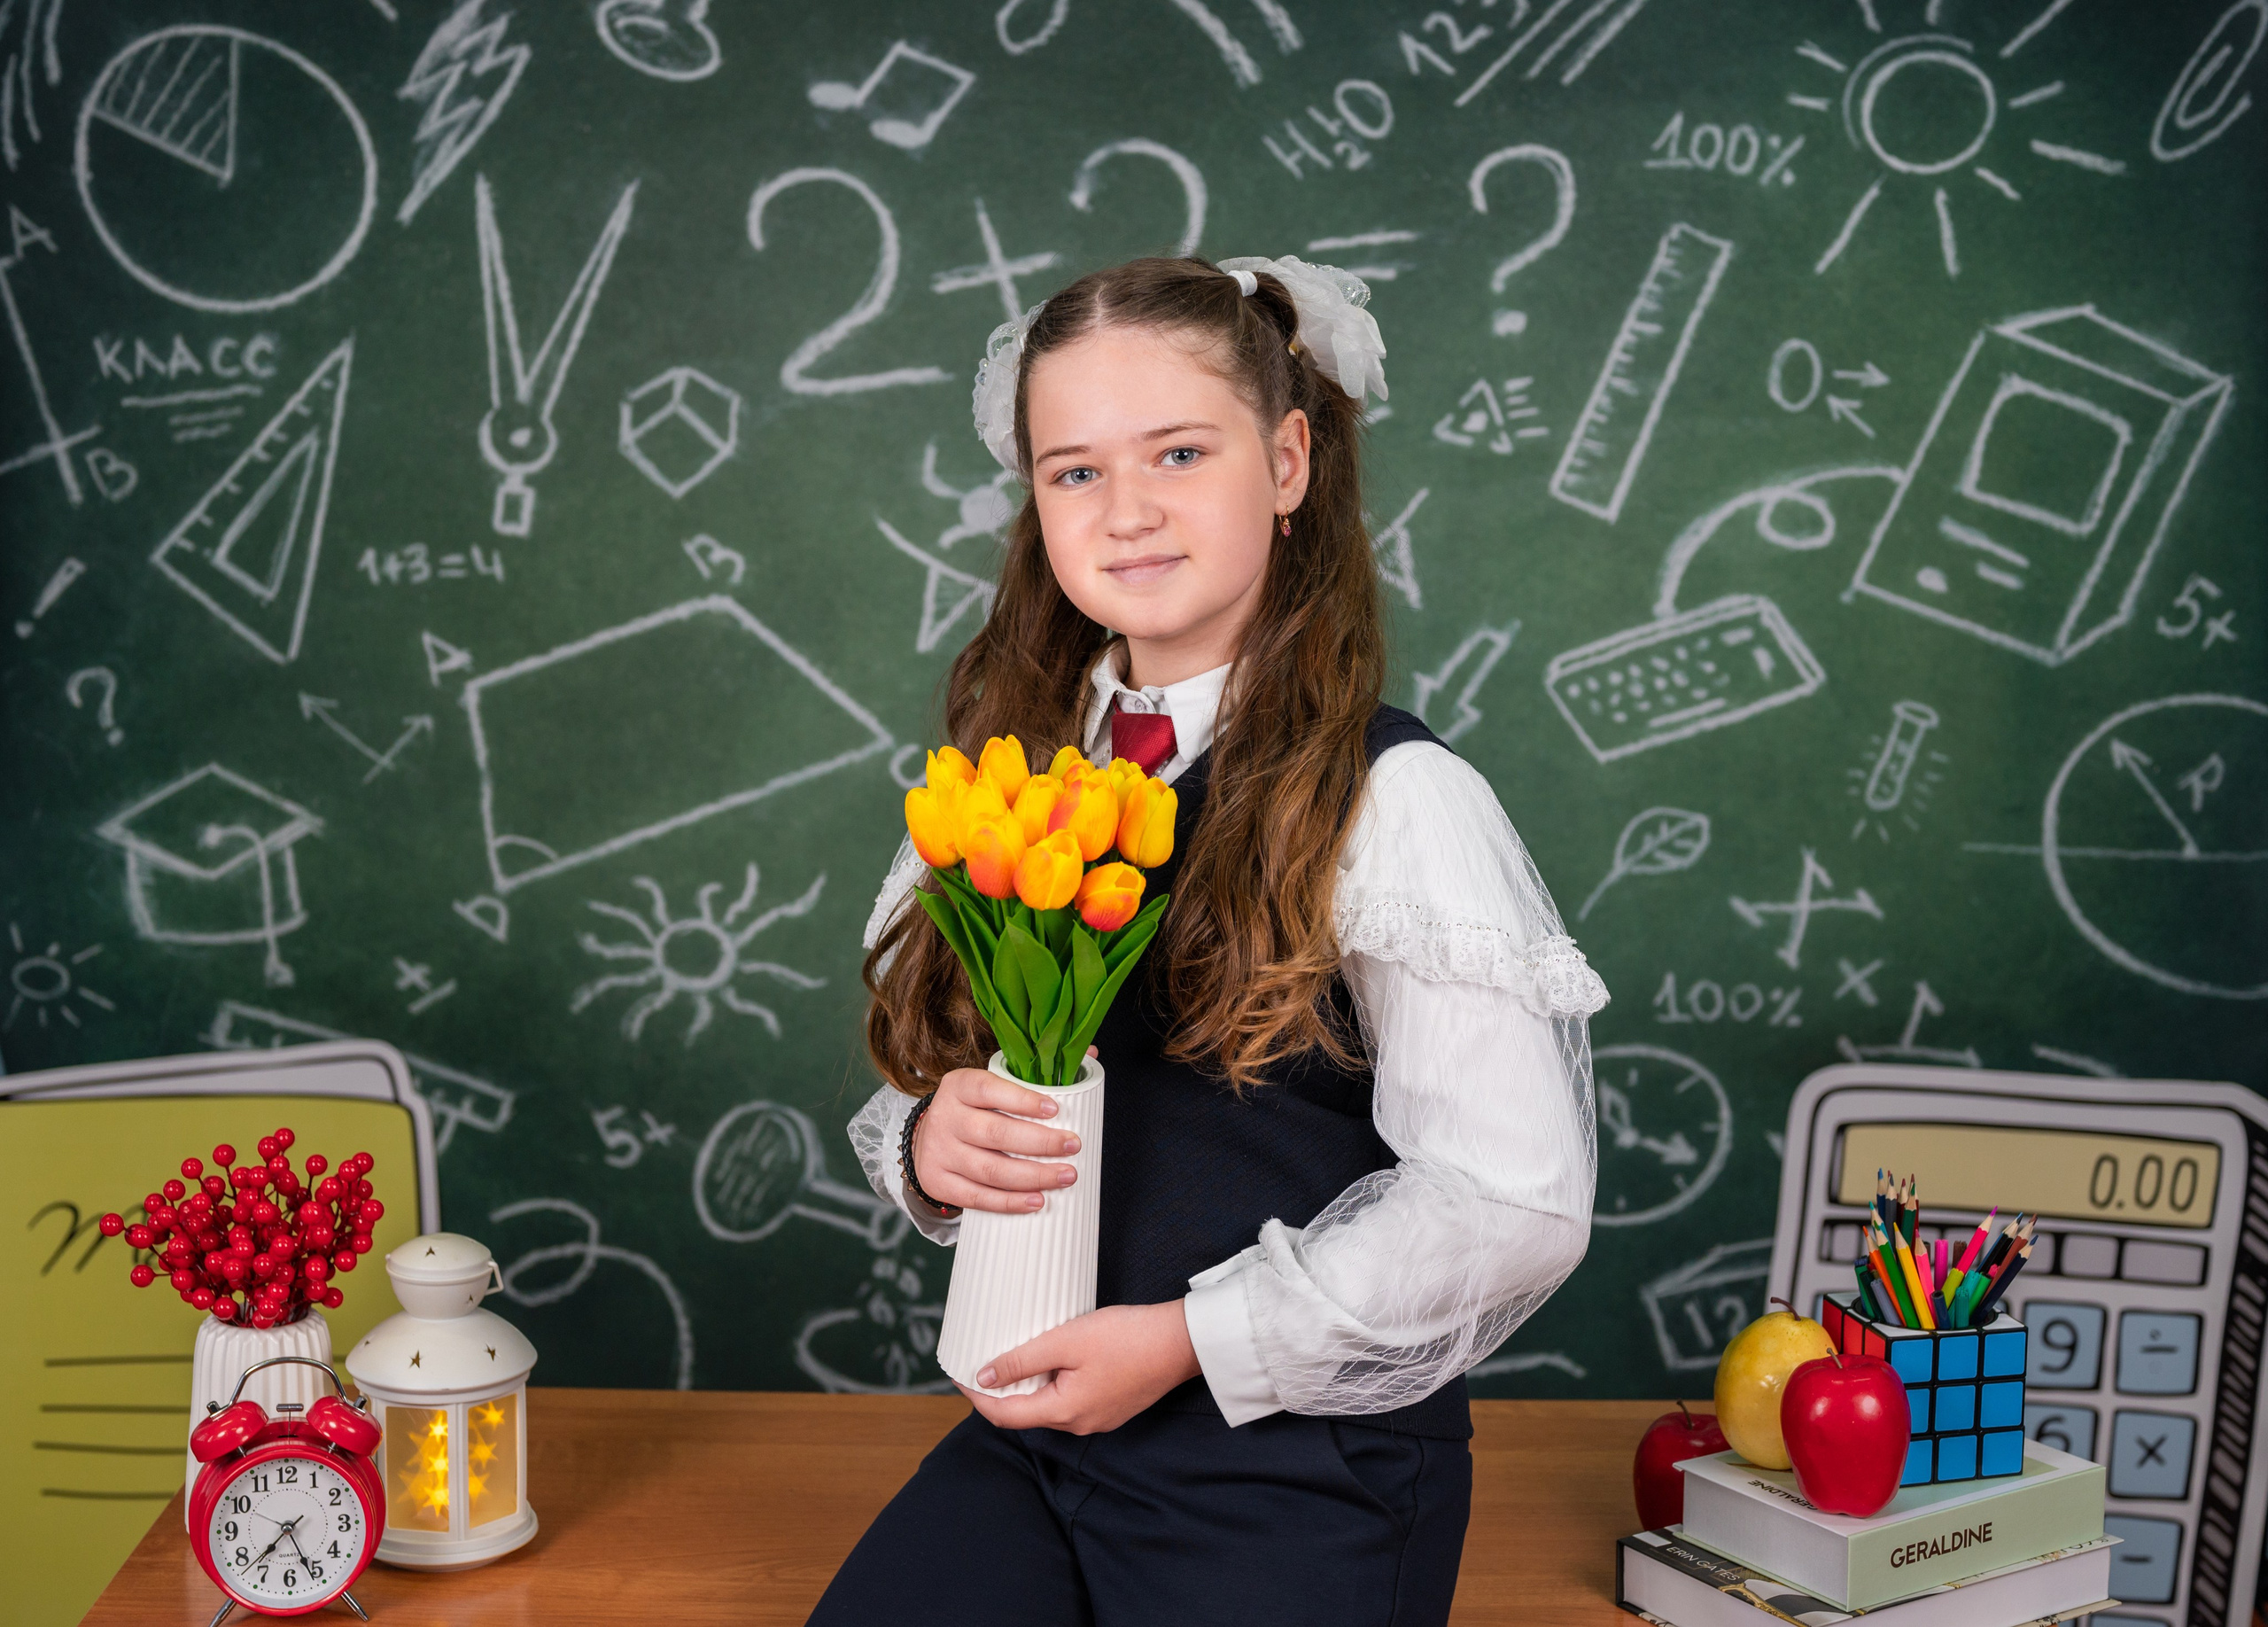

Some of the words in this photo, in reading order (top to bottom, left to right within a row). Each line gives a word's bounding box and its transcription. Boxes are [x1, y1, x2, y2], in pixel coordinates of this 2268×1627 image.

[1642, 109, 1806, 186] 100%
[9, 202, 59, 261] A
[92, 332, 278, 385] КЛАСС
[355, 541, 506, 587] 1+3=4
[1653, 971, 1804, 1028] 100%
[2088, 1153, 2200, 1214] 0.00
[2039, 1317, 2078, 1375] 9
[252, 1474, 270, 1493] 11
[276, 1465, 298, 1485] 12
[309, 1470, 319, 1489] 1
[230, 1494, 252, 1515] 10
[328, 1488, 342, 1506] 2
[224, 1521, 239, 1542] 9
[338, 1514, 352, 1533] 3
[327, 1539, 341, 1559] 4
[1890, 1522, 1993, 1569] GERALDINE
[235, 1546, 250, 1567] 8
[1666, 1546, 1699, 1562] ERIN
[1696, 1560, 1741, 1582] GATES
[257, 1565, 269, 1584] 7
[283, 1569, 297, 1588] 6
[311, 1560, 323, 1579] 5
